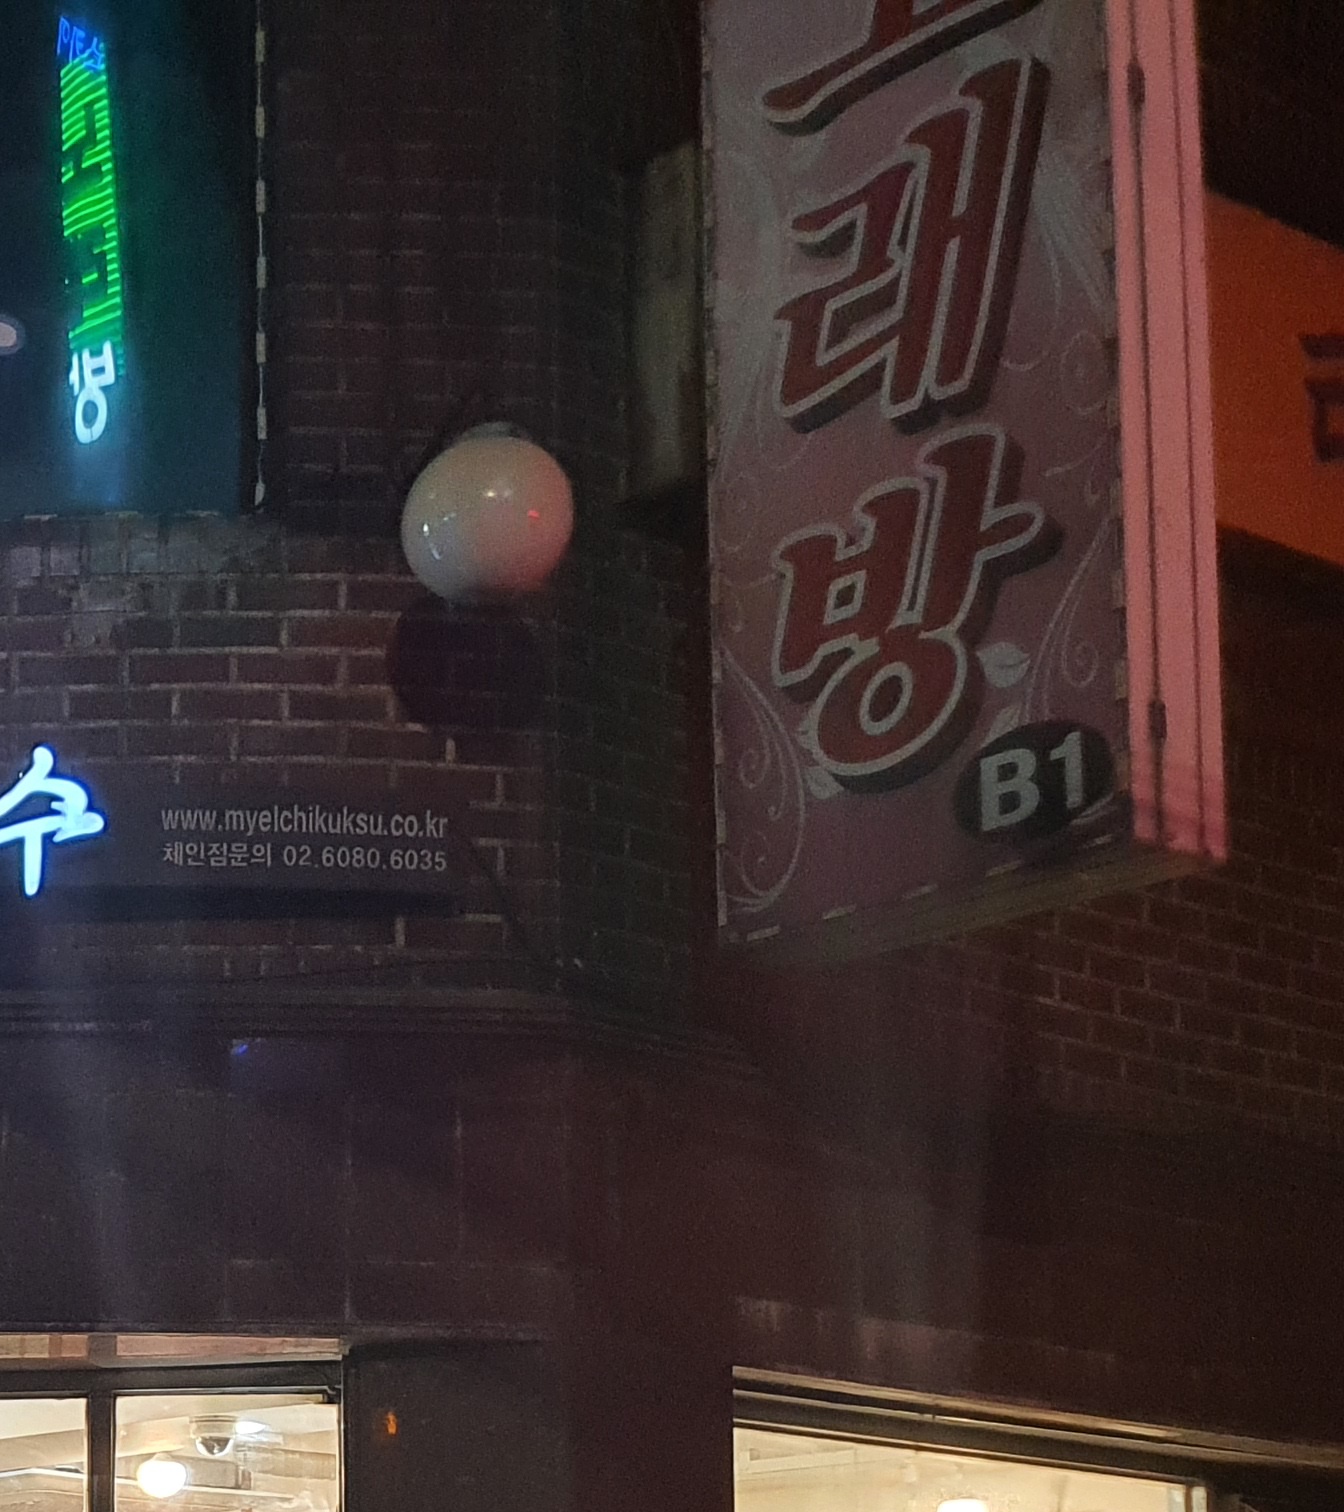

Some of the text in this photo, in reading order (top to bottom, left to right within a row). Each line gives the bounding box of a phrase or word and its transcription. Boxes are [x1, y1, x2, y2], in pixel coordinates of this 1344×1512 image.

[979, 730, 1089, 832] B1
[161, 805, 449, 838] www.myelchikuksu.co.kr
[163, 842, 448, 871] 체인점문의 02.6080.6035
